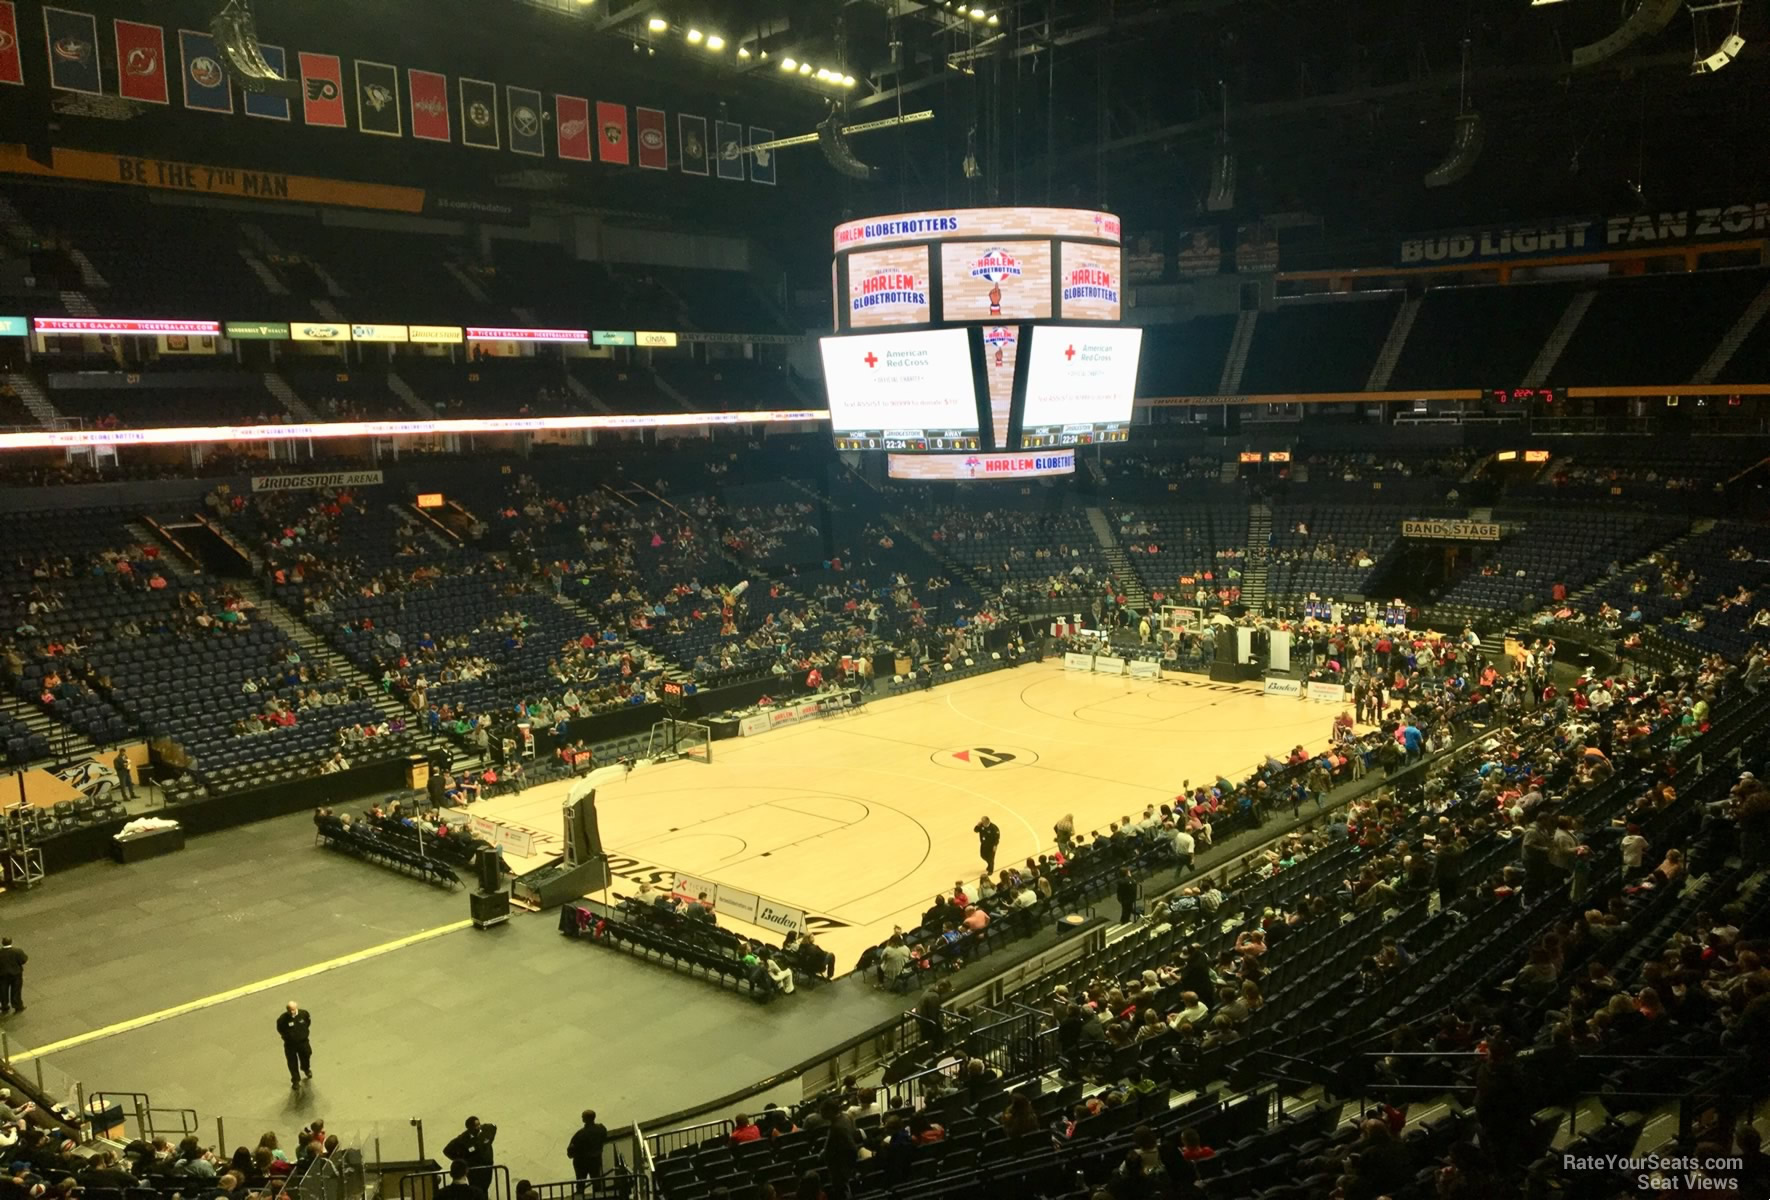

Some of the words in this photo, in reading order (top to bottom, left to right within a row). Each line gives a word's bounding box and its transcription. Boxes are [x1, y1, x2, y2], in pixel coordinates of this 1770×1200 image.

[120, 158, 147, 182] BE
[156, 161, 196, 188] THE
[208, 168, 234, 190] 7TH
[242, 173, 288, 197] MAN
[839, 227, 864, 243] HARLEM
[866, 217, 957, 238] GLOBETROTTERS
[1608, 211, 1688, 244] FAN
[1401, 236, 1475, 262] BUD
[1480, 222, 1592, 256] LIGHT
[978, 258, 1014, 267] HARLEM
[973, 267, 1020, 276] GLOBETROTTERS
[863, 274, 913, 294] HARLEM
[1072, 270, 1109, 288] HARLEM
[308, 328, 333, 337] Ford
[886, 350, 928, 358] American
[869, 439, 875, 448] 0
[937, 439, 943, 448] 0
[1062, 436, 1078, 444] 22:24
[986, 459, 1033, 472] HARLEM
[258, 474, 344, 490] BRIDGESTONE
[348, 474, 379, 484] ARENA
[1406, 524, 1441, 534] BAND
[1454, 525, 1496, 535] STAGE
[1268, 682, 1298, 692] Baden
[775, 712, 792, 720] HARLEM
[761, 907, 796, 929] Baden
